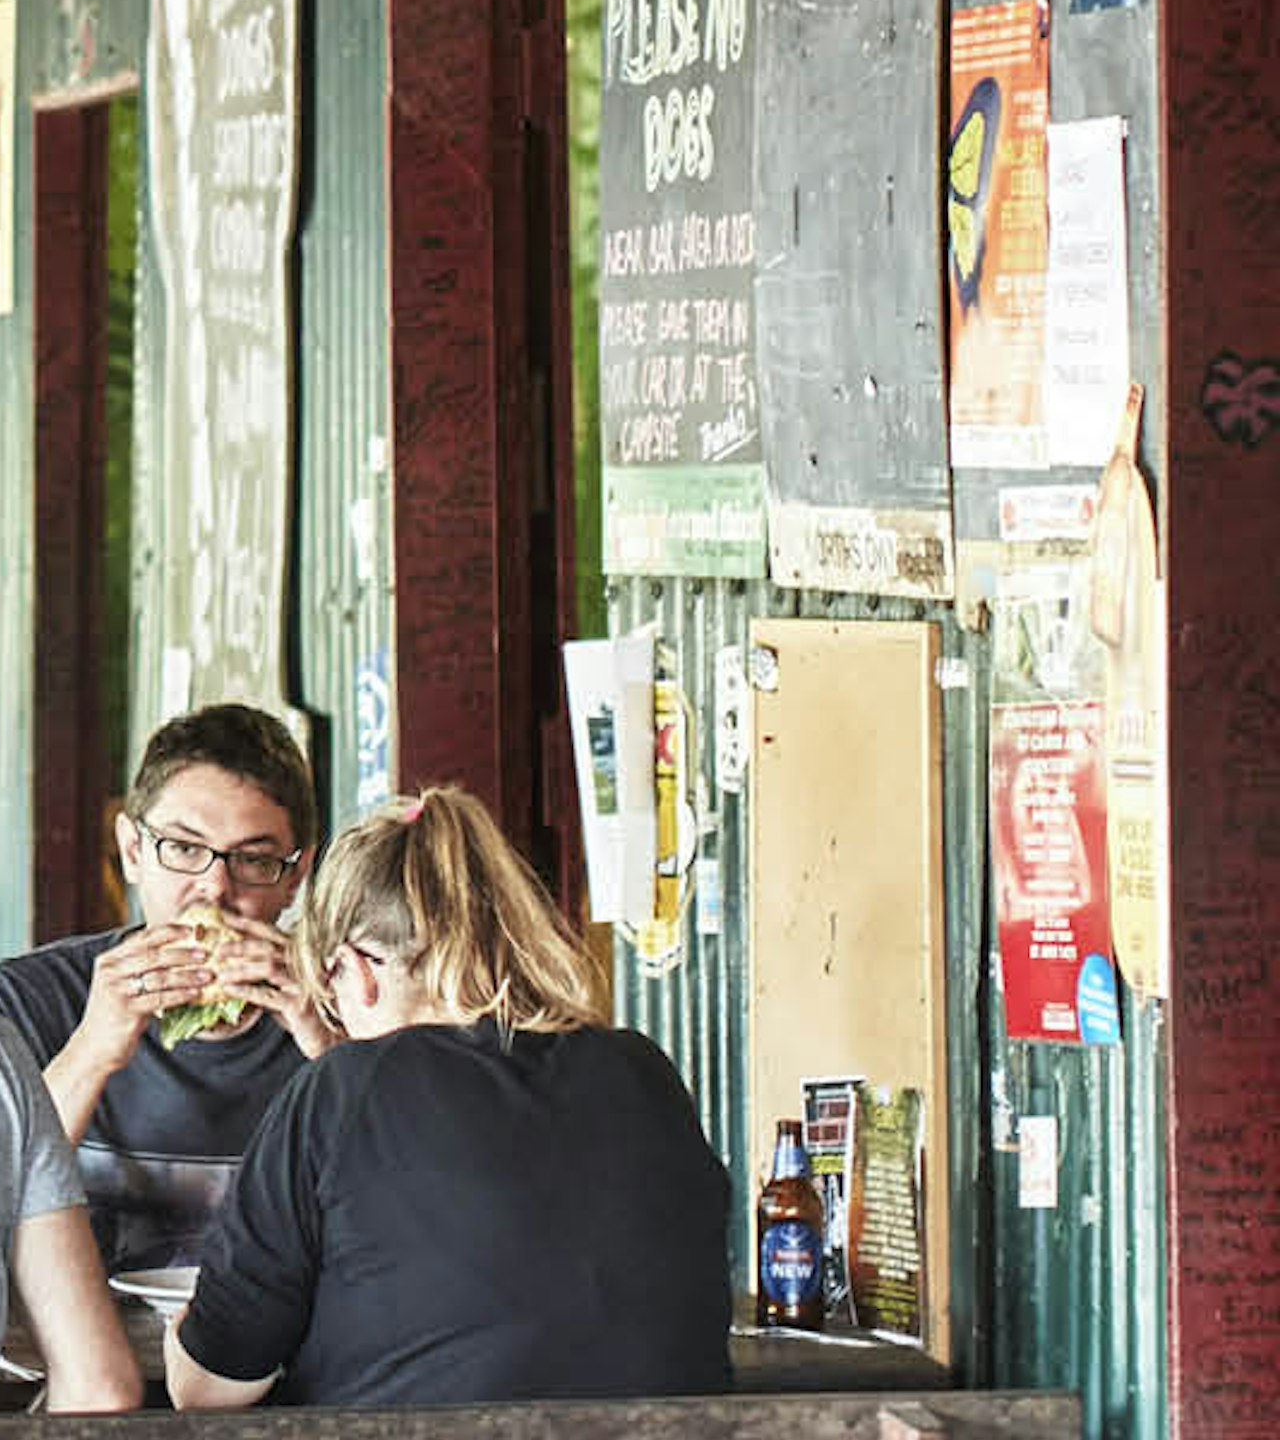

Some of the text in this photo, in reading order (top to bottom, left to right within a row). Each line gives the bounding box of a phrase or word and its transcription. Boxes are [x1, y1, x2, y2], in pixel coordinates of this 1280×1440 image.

[643, 84, 715, 193] DOGS
[690, 352, 712, 404] AT
[771, 1262, 815, 1279] NEW
